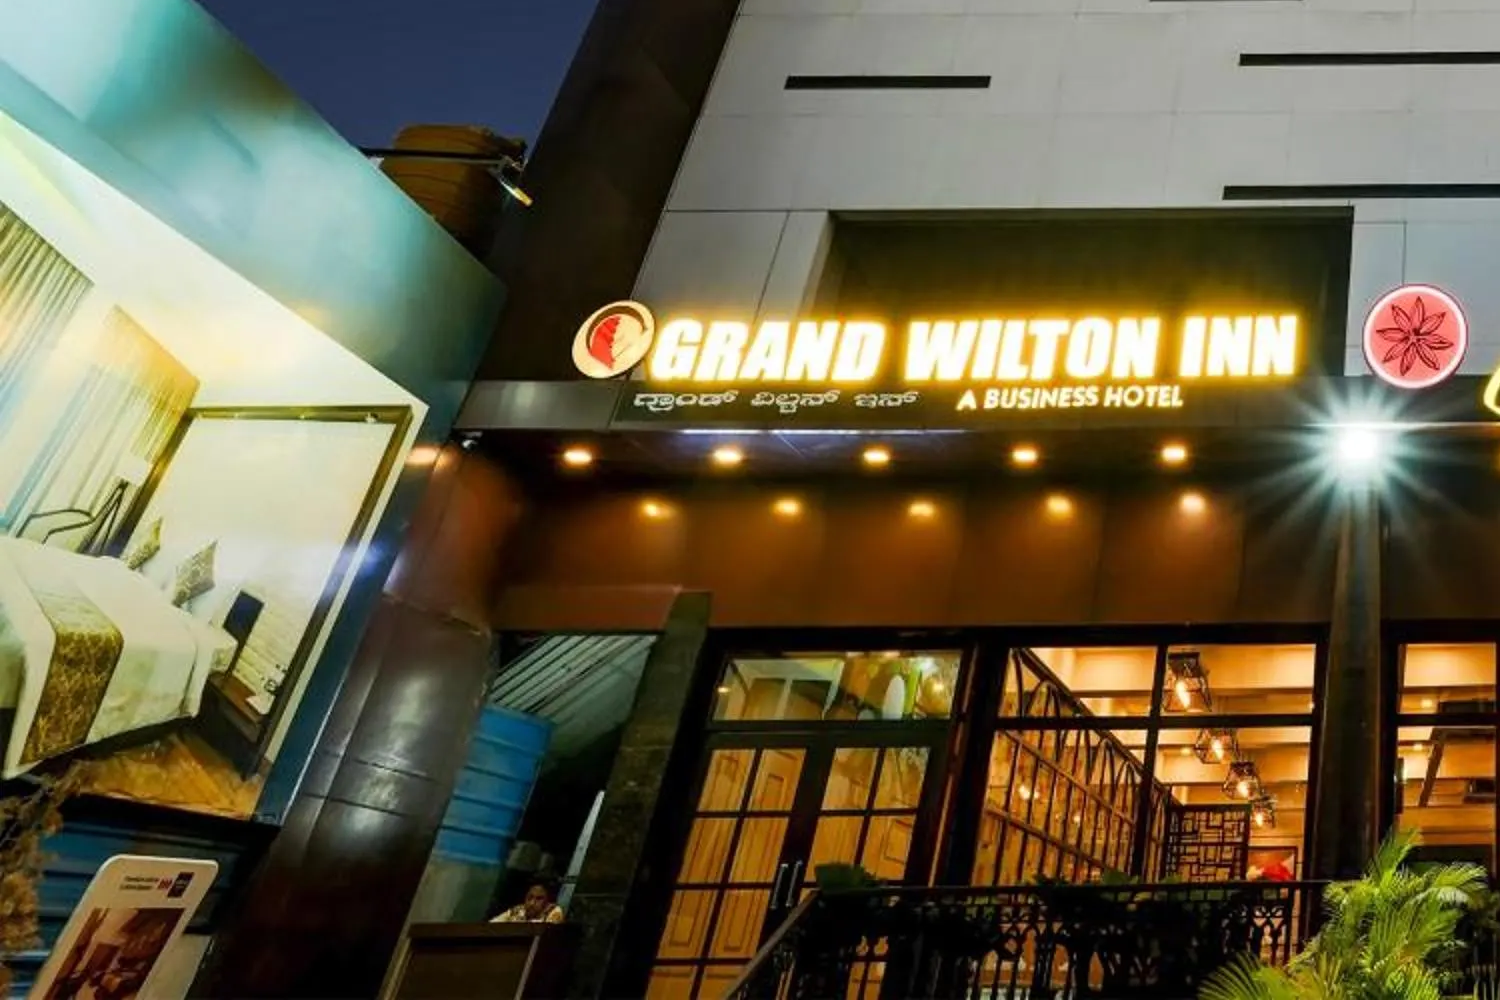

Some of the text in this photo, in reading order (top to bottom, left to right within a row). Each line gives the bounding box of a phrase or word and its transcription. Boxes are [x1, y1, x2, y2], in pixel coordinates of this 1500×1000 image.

[650, 315, 1298, 382] GRAND WILTON INN
[957, 385, 1184, 411] A BUSINESS HOTEL
